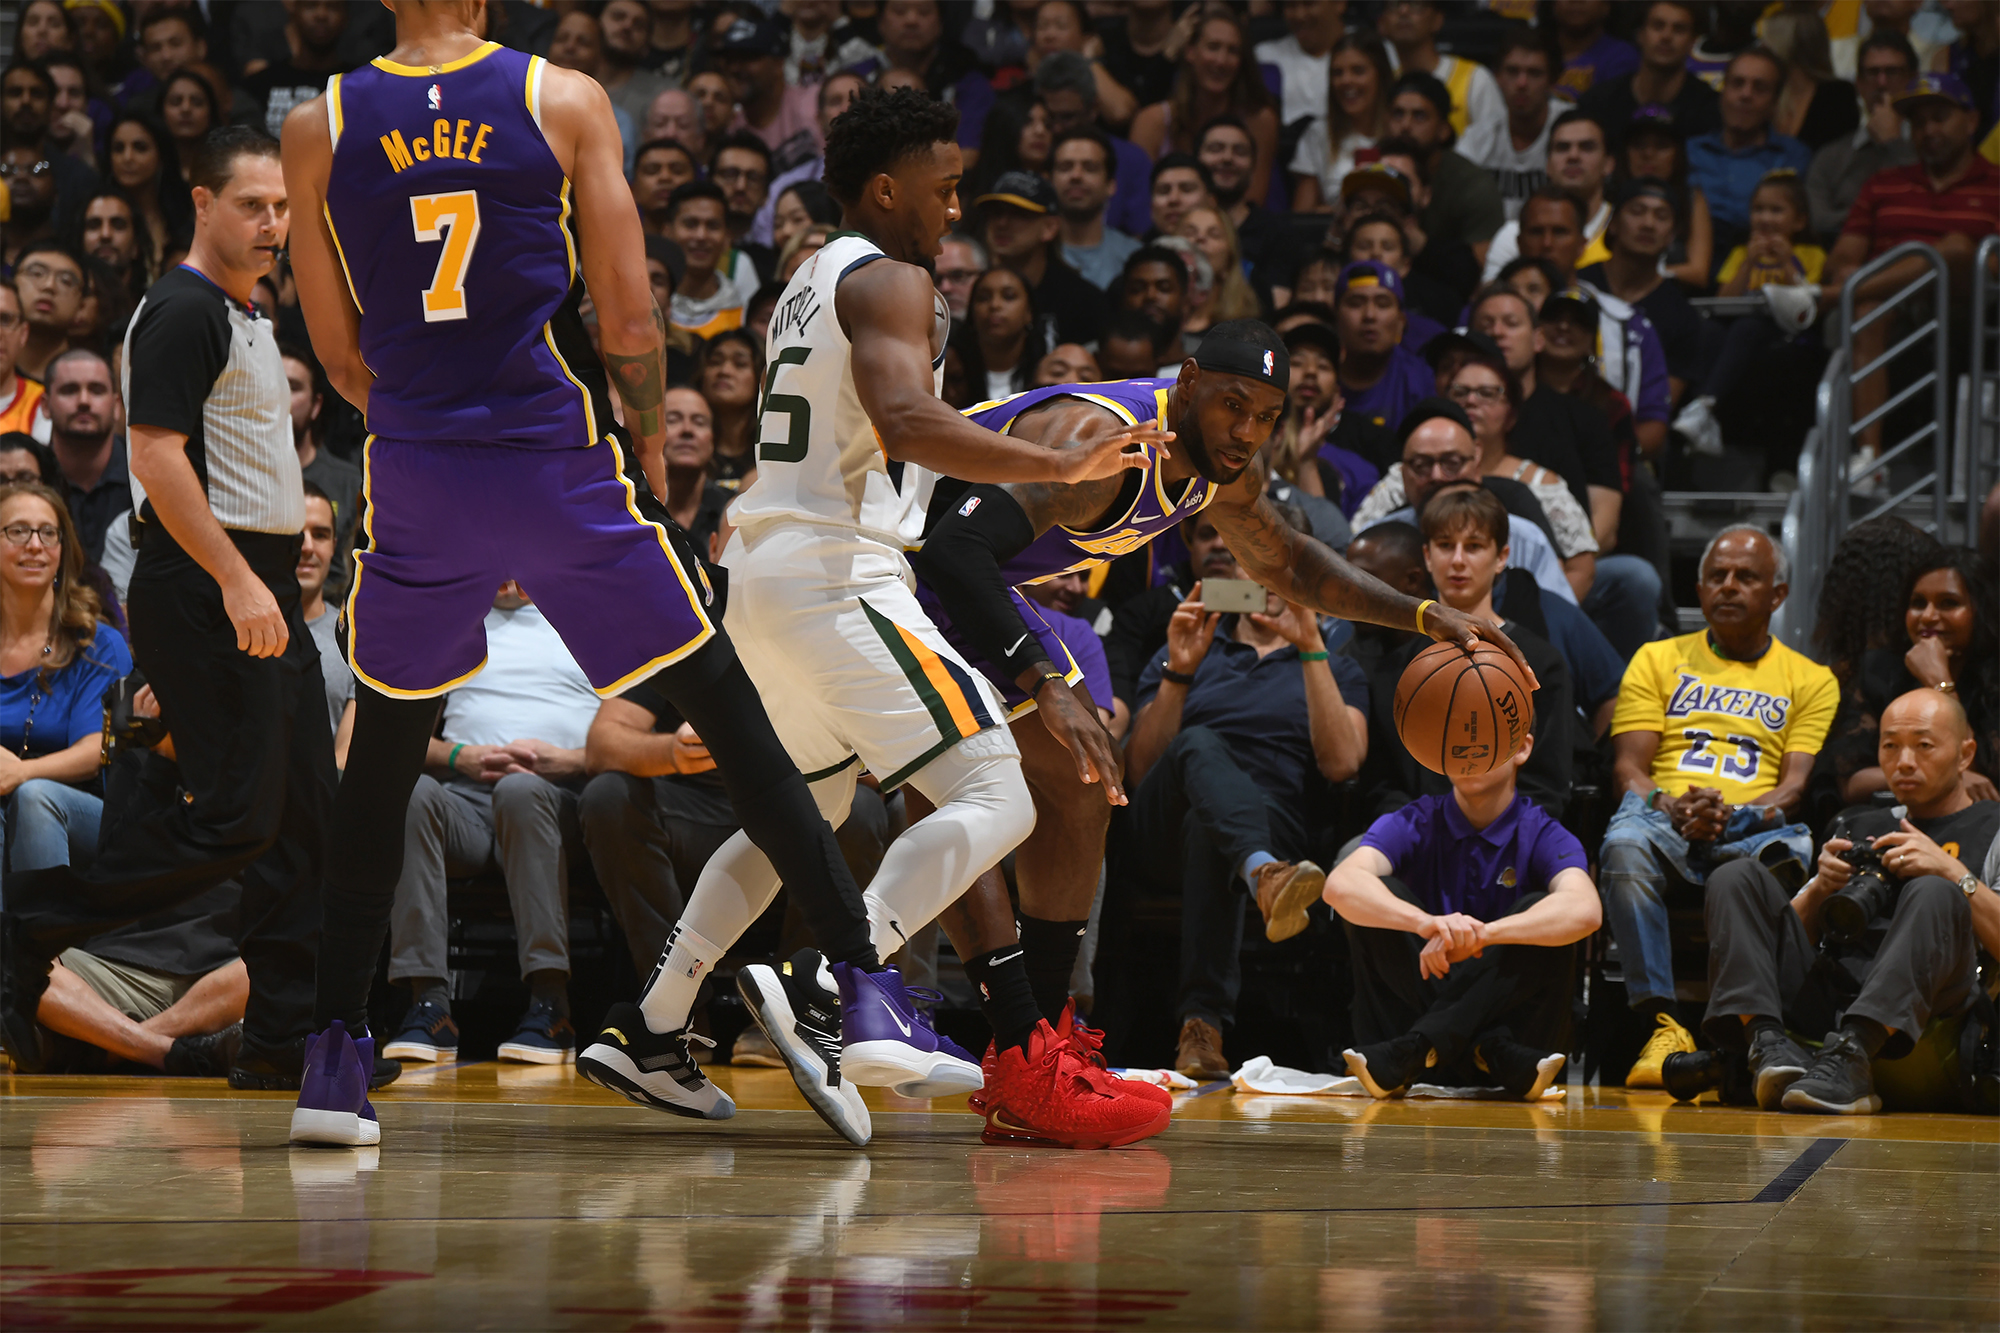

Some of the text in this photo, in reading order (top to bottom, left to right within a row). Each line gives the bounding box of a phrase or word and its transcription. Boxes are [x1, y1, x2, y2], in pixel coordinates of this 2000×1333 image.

[379, 118, 494, 173] McGEE
[409, 189, 482, 323] 7
[772, 285, 821, 342] MITCLL
[755, 346, 811, 463] 5
[1184, 490, 1204, 509] wish
[1665, 673, 1791, 732] LAKERS
[1677, 728, 1762, 784] 23
